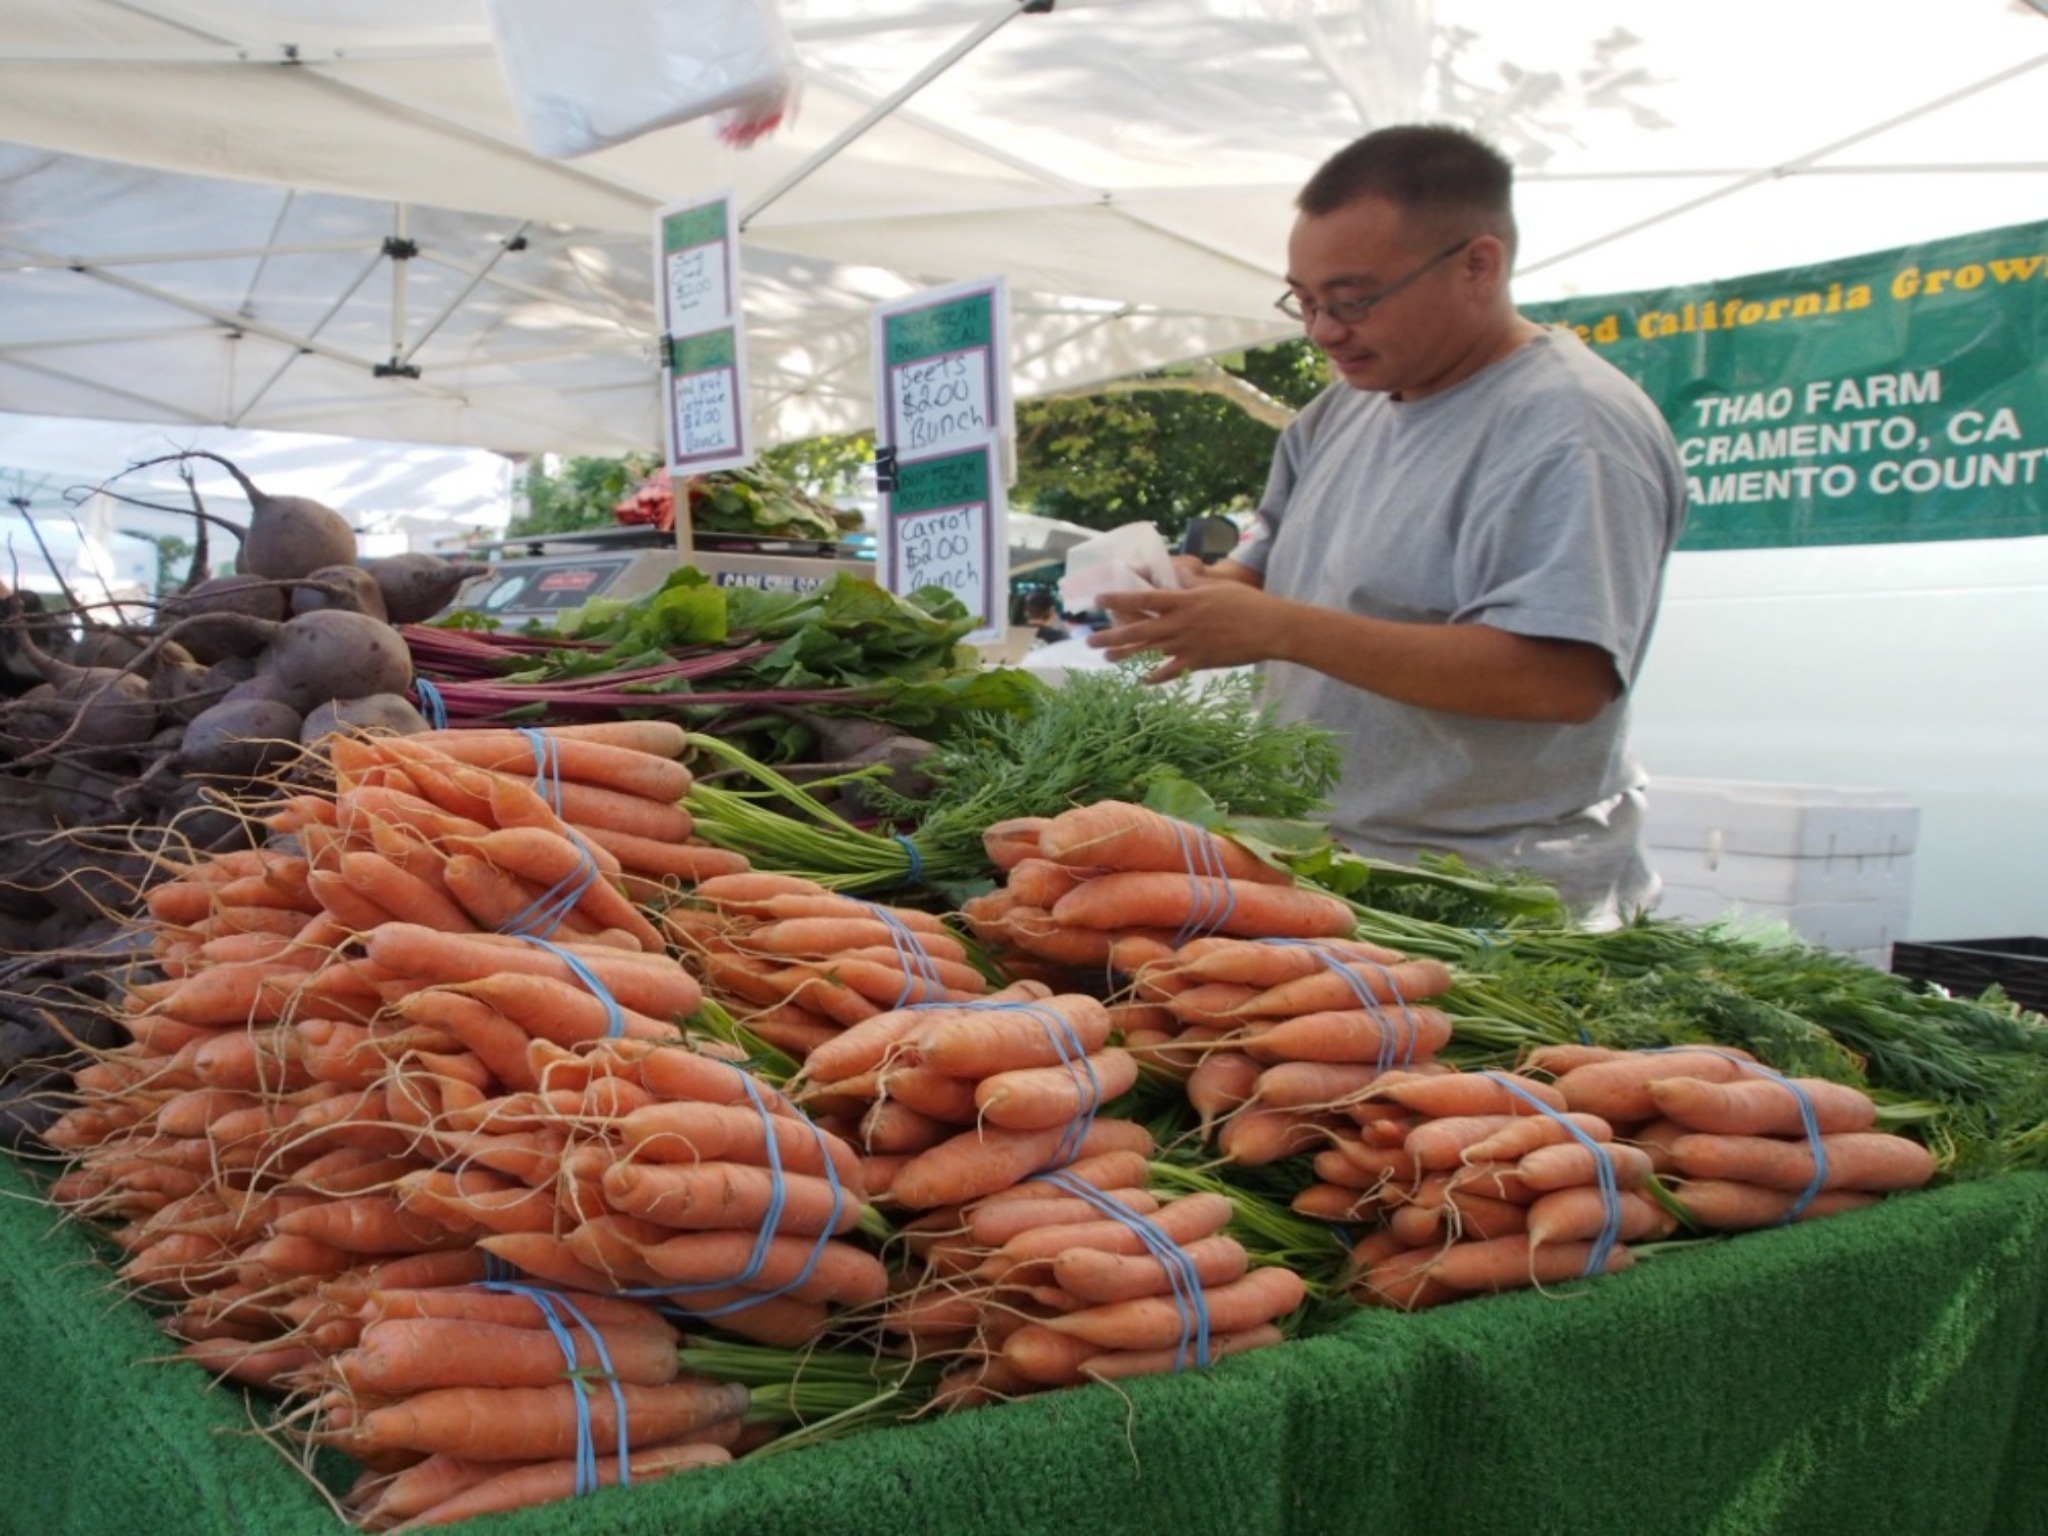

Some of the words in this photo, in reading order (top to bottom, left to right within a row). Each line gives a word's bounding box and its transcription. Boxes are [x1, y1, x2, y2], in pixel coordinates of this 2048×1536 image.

[1637, 283, 1871, 339] California
[1891, 254, 2048, 301] Grow
[911, 404, 985, 449] Bunch
[1694, 387, 1793, 428] THAO
[1805, 370, 1941, 415] FARM
[1678, 416, 1930, 468] CRAMENTO,
[1947, 407, 2022, 446] CA
[1687, 464, 1857, 506] AMENTO
[1869, 447, 2048, 495] COUNT
